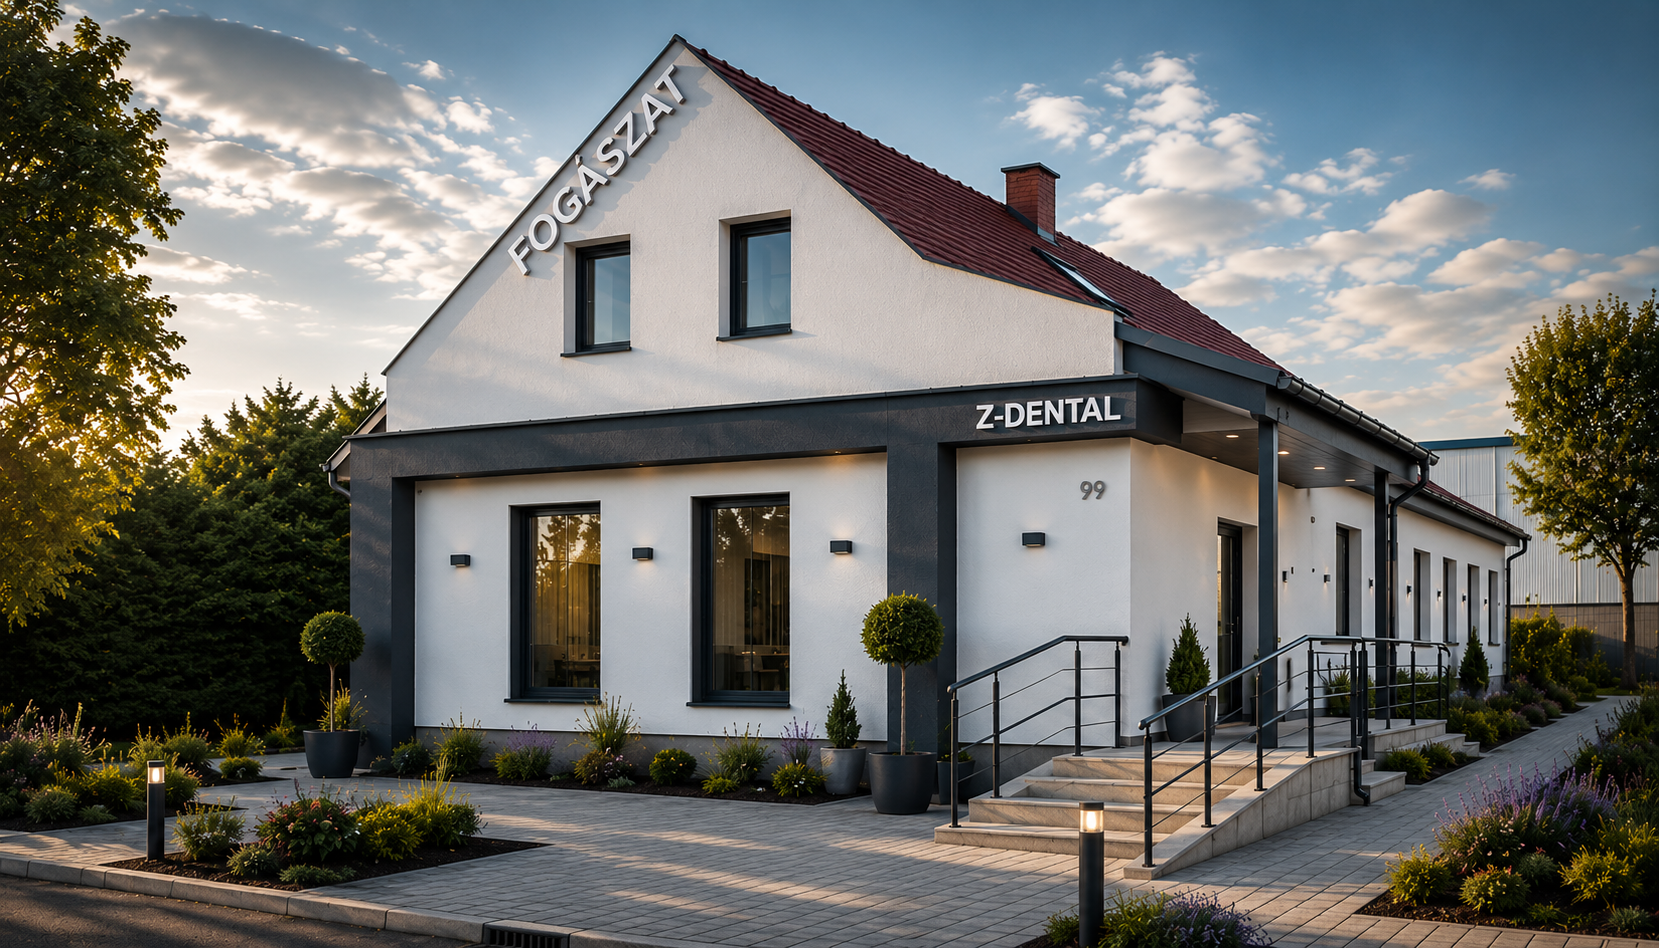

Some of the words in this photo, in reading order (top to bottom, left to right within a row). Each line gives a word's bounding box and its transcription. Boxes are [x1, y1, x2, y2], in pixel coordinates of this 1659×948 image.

[507, 64, 685, 276] FOGÁSZAT
[976, 396, 1121, 429] Z-DENTAL
[1080, 480, 1106, 500] 99
